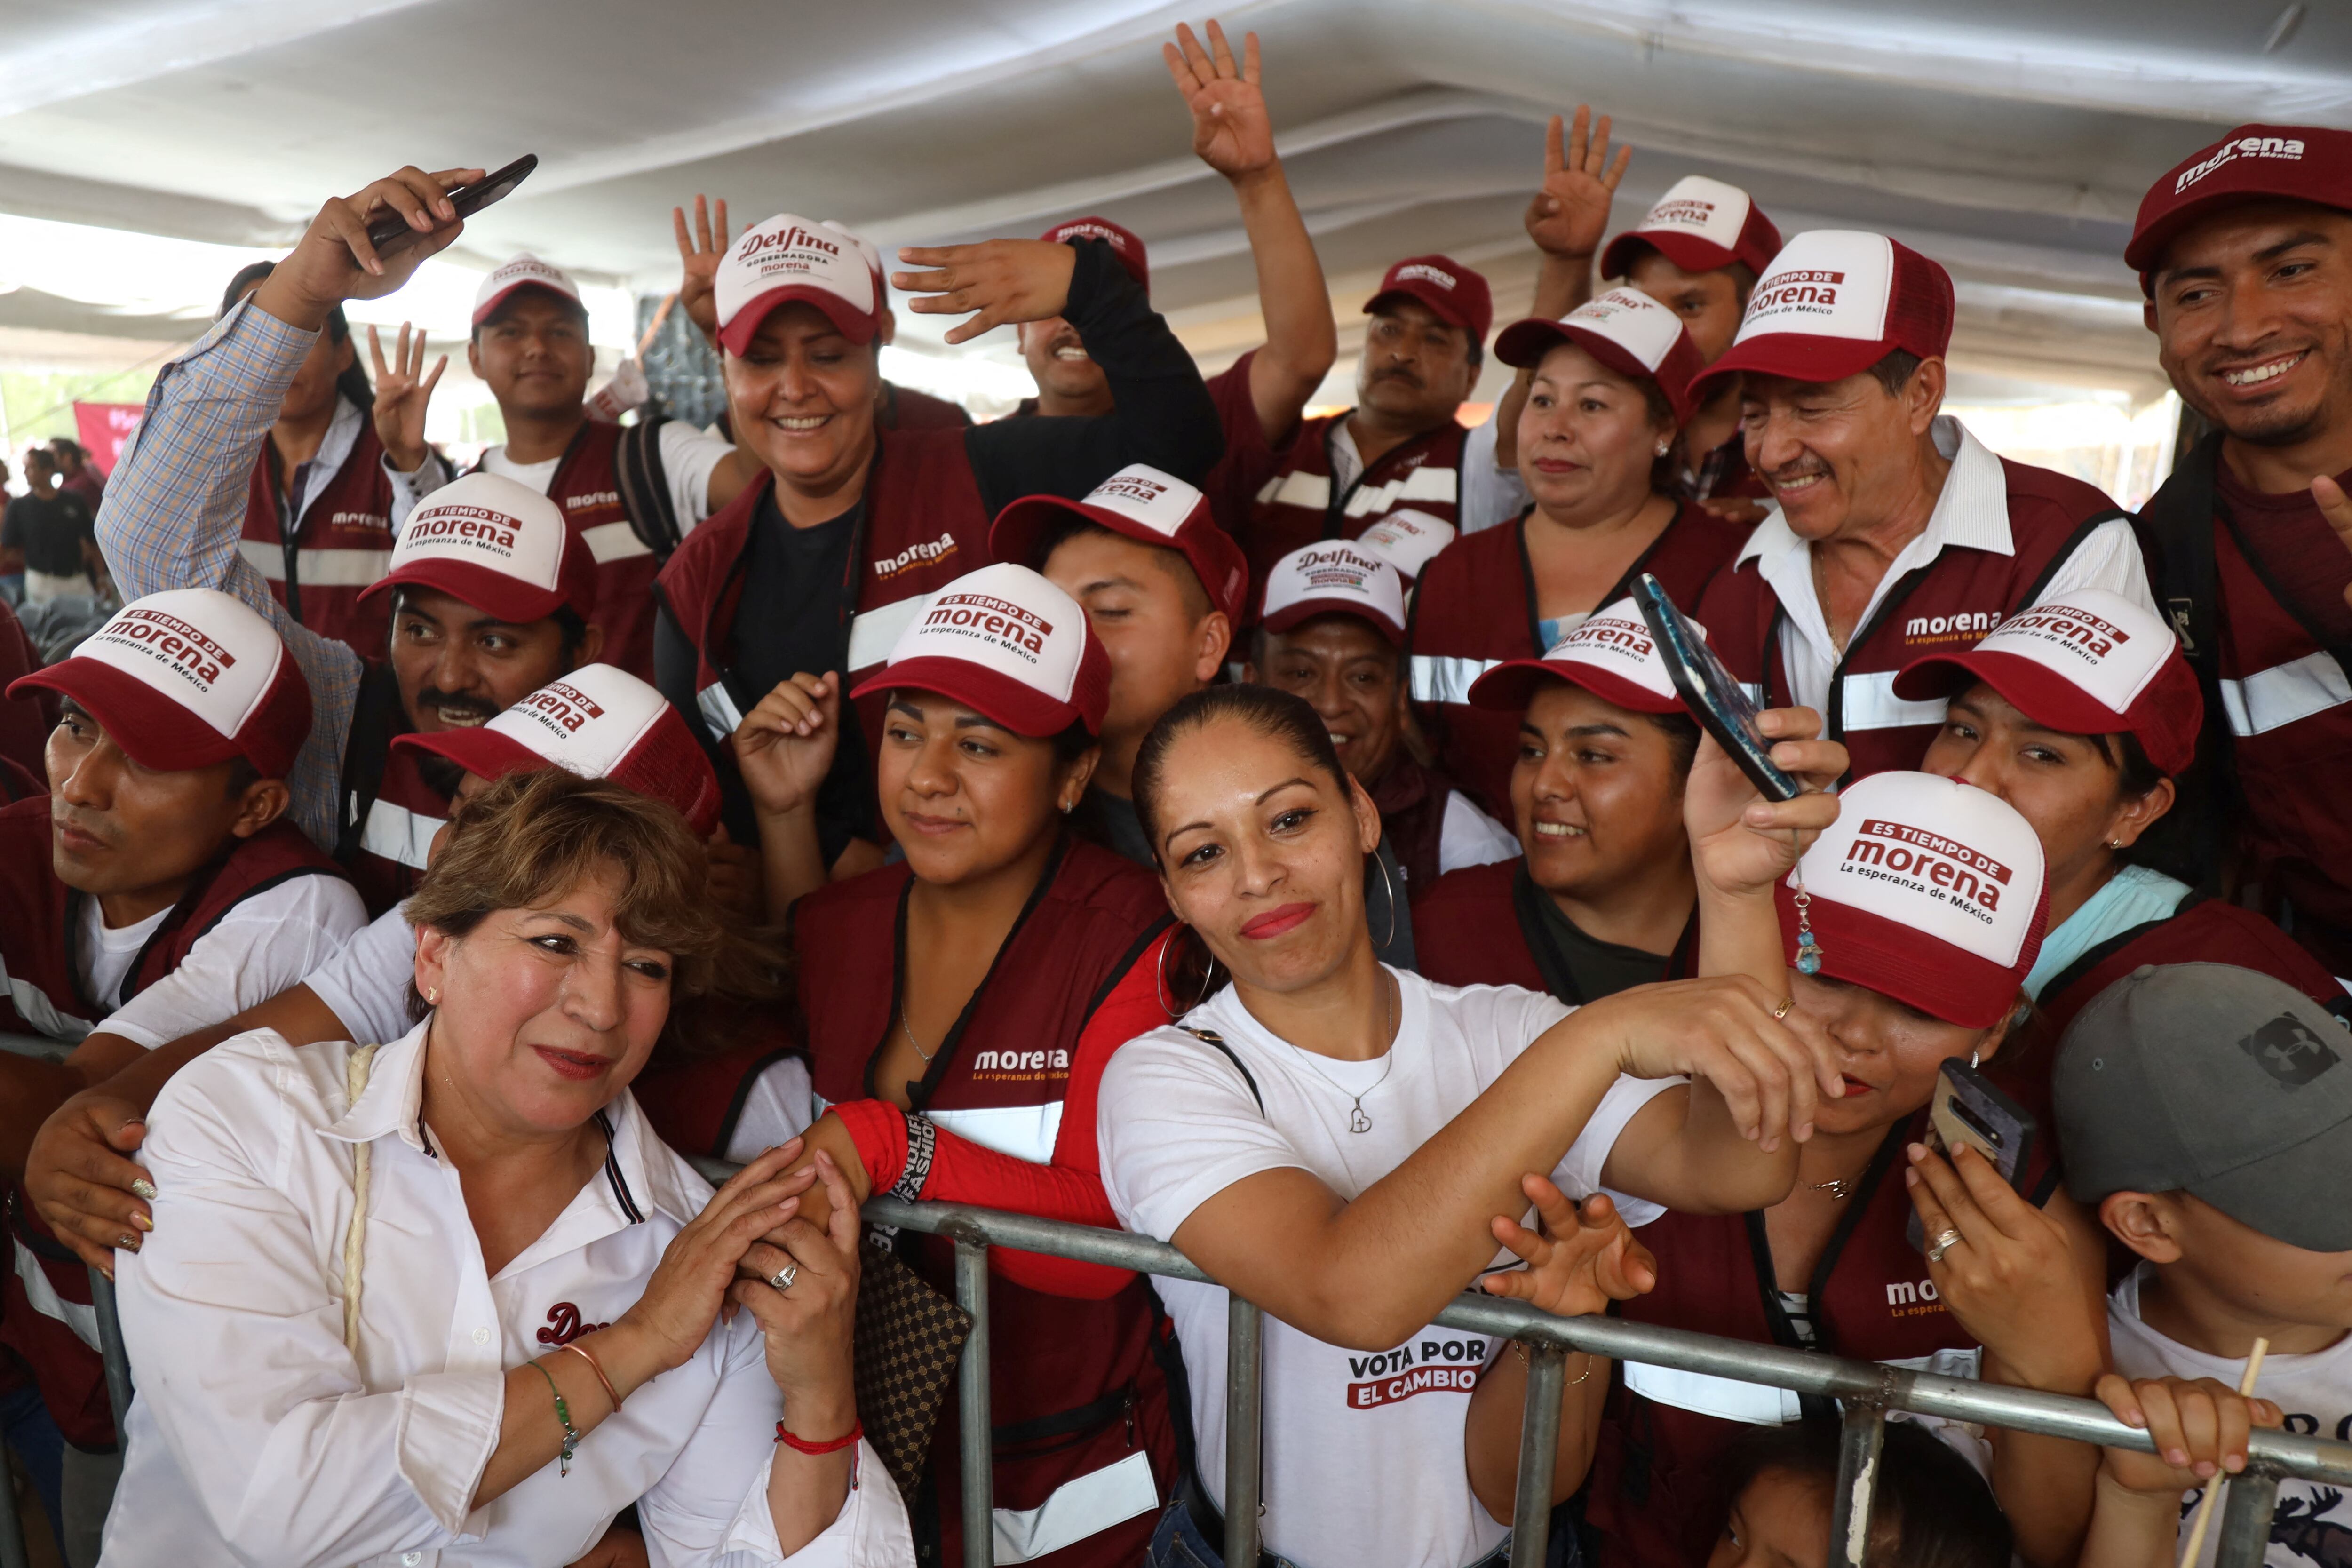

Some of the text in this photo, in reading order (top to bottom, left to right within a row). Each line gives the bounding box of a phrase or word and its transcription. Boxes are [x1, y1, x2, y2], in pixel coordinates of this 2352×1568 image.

[2176, 137, 2305, 189] morena
[2259, 151, 2302, 160] México
[738, 226, 839, 261] Delfina
[747, 253, 828, 267] GOBERNADORA
[761, 262, 810, 273] morena
[1765, 272, 1809, 288] TIEMPO
[1813, 273, 1833, 281] DE
[1745, 286, 1836, 320] morena
[1796, 305, 1832, 315] México
[566, 492, 618, 509] moren
[1096, 484, 1157, 501] rena
[423, 507, 511, 525] ES TIEMPO DE
[408, 520, 515, 549] morena
[415, 537, 457, 546] esperanza
[476, 541, 511, 557] México
[874, 533, 955, 574] morena
[1296, 548, 1376, 572] Delfina
[945, 596, 1042, 629] ES TIEMPO DE
[1906, 612, 2002, 636] morena
[2041, 606, 2094, 622] TIEMPO
[2095, 621, 2118, 636] DE
[148, 612, 203, 642] TIEMPO
[202, 641, 225, 659] DE
[925, 608, 1043, 655] morena
[930, 627, 980, 638] esperanza
[984, 634, 997, 644] de
[1000, 640, 1037, 664] México
[1917, 634, 1959, 644] esperanza
[1997, 616, 2112, 658] morena
[104, 621, 220, 684] morena
[107, 636, 153, 655] esperanza
[155, 653, 169, 664] de
[171, 662, 207, 692] México
[1609, 645, 1645, 663] México
[2060, 640, 2098, 665] México
[545, 683, 595, 711] IEMPO DE
[520, 693, 585, 732] orena
[538, 716, 567, 739] México
[1872, 823, 2000, 876] ES TIEMPO DE
[1847, 839, 2000, 912] morena
[1840, 862, 1993, 925] La esperanza de México
[1034, 1072, 1046, 1080] de
[1908, 1305, 1945, 1315] espera
[1349, 1340, 1486, 1378] VOTA POR
[1358, 1370, 1476, 1405] EL CAMBIO
